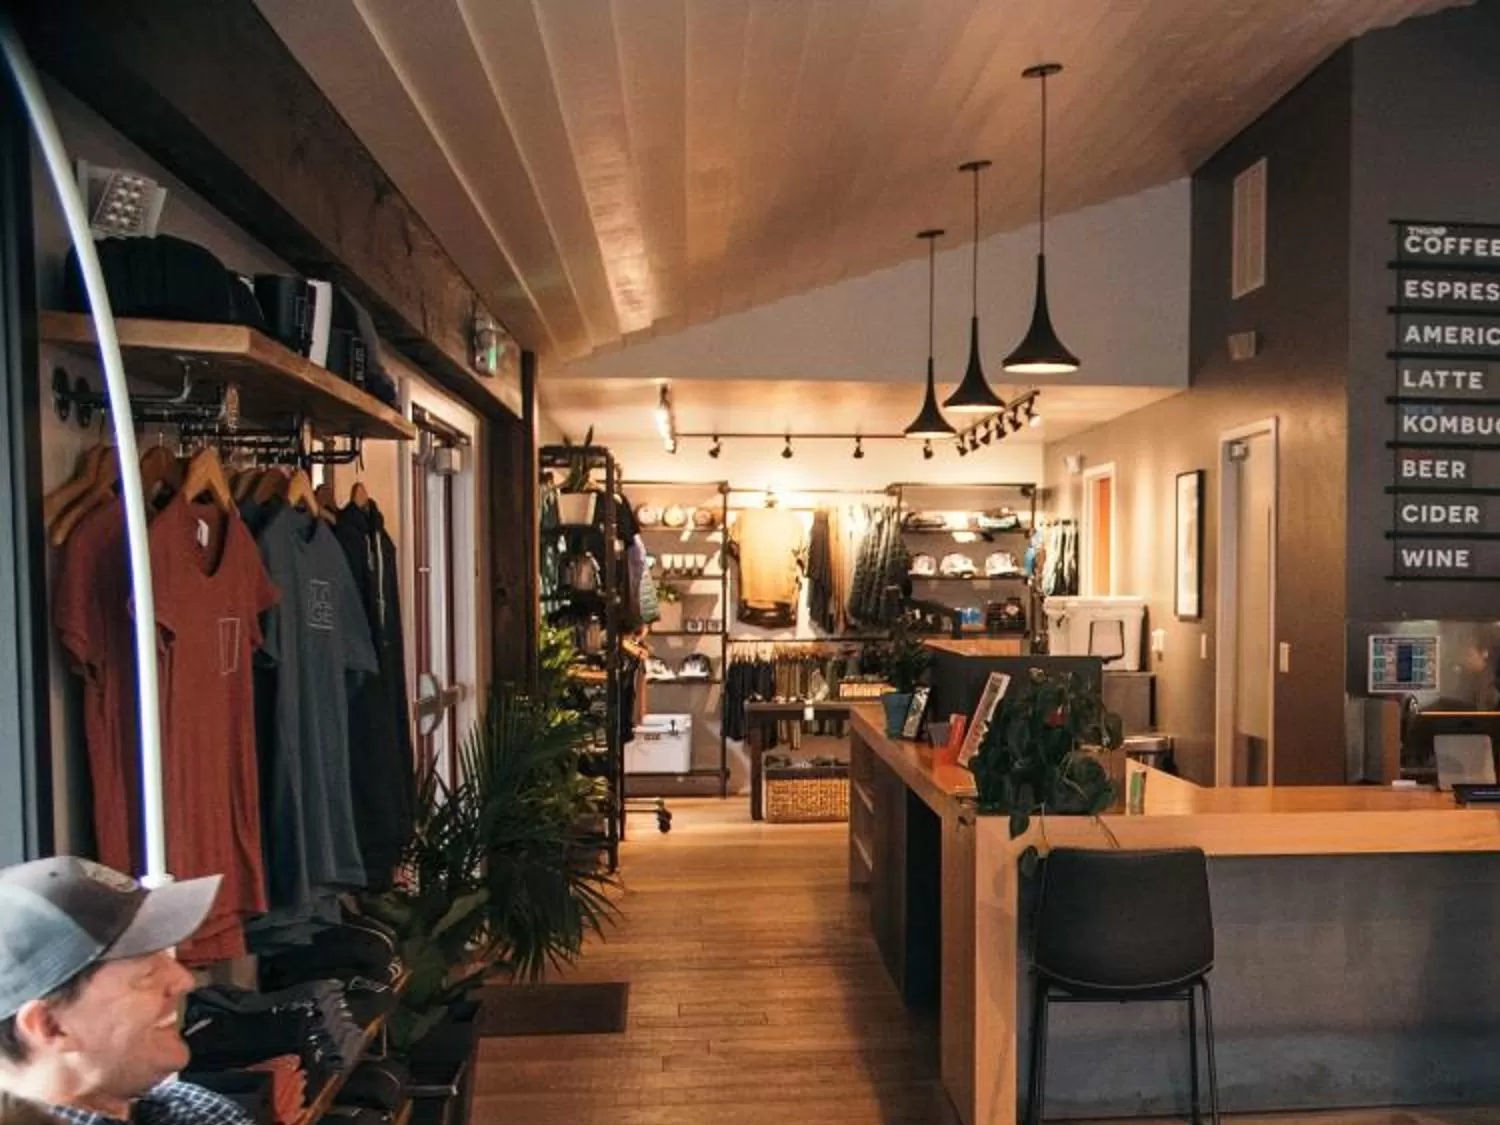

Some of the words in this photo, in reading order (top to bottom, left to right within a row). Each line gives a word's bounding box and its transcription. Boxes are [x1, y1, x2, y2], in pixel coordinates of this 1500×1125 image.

[1403, 369, 1483, 390] LATTE
[1402, 459, 1466, 479] BEER
[1401, 504, 1479, 523] CIDER
[1401, 549, 1469, 568] WINE
